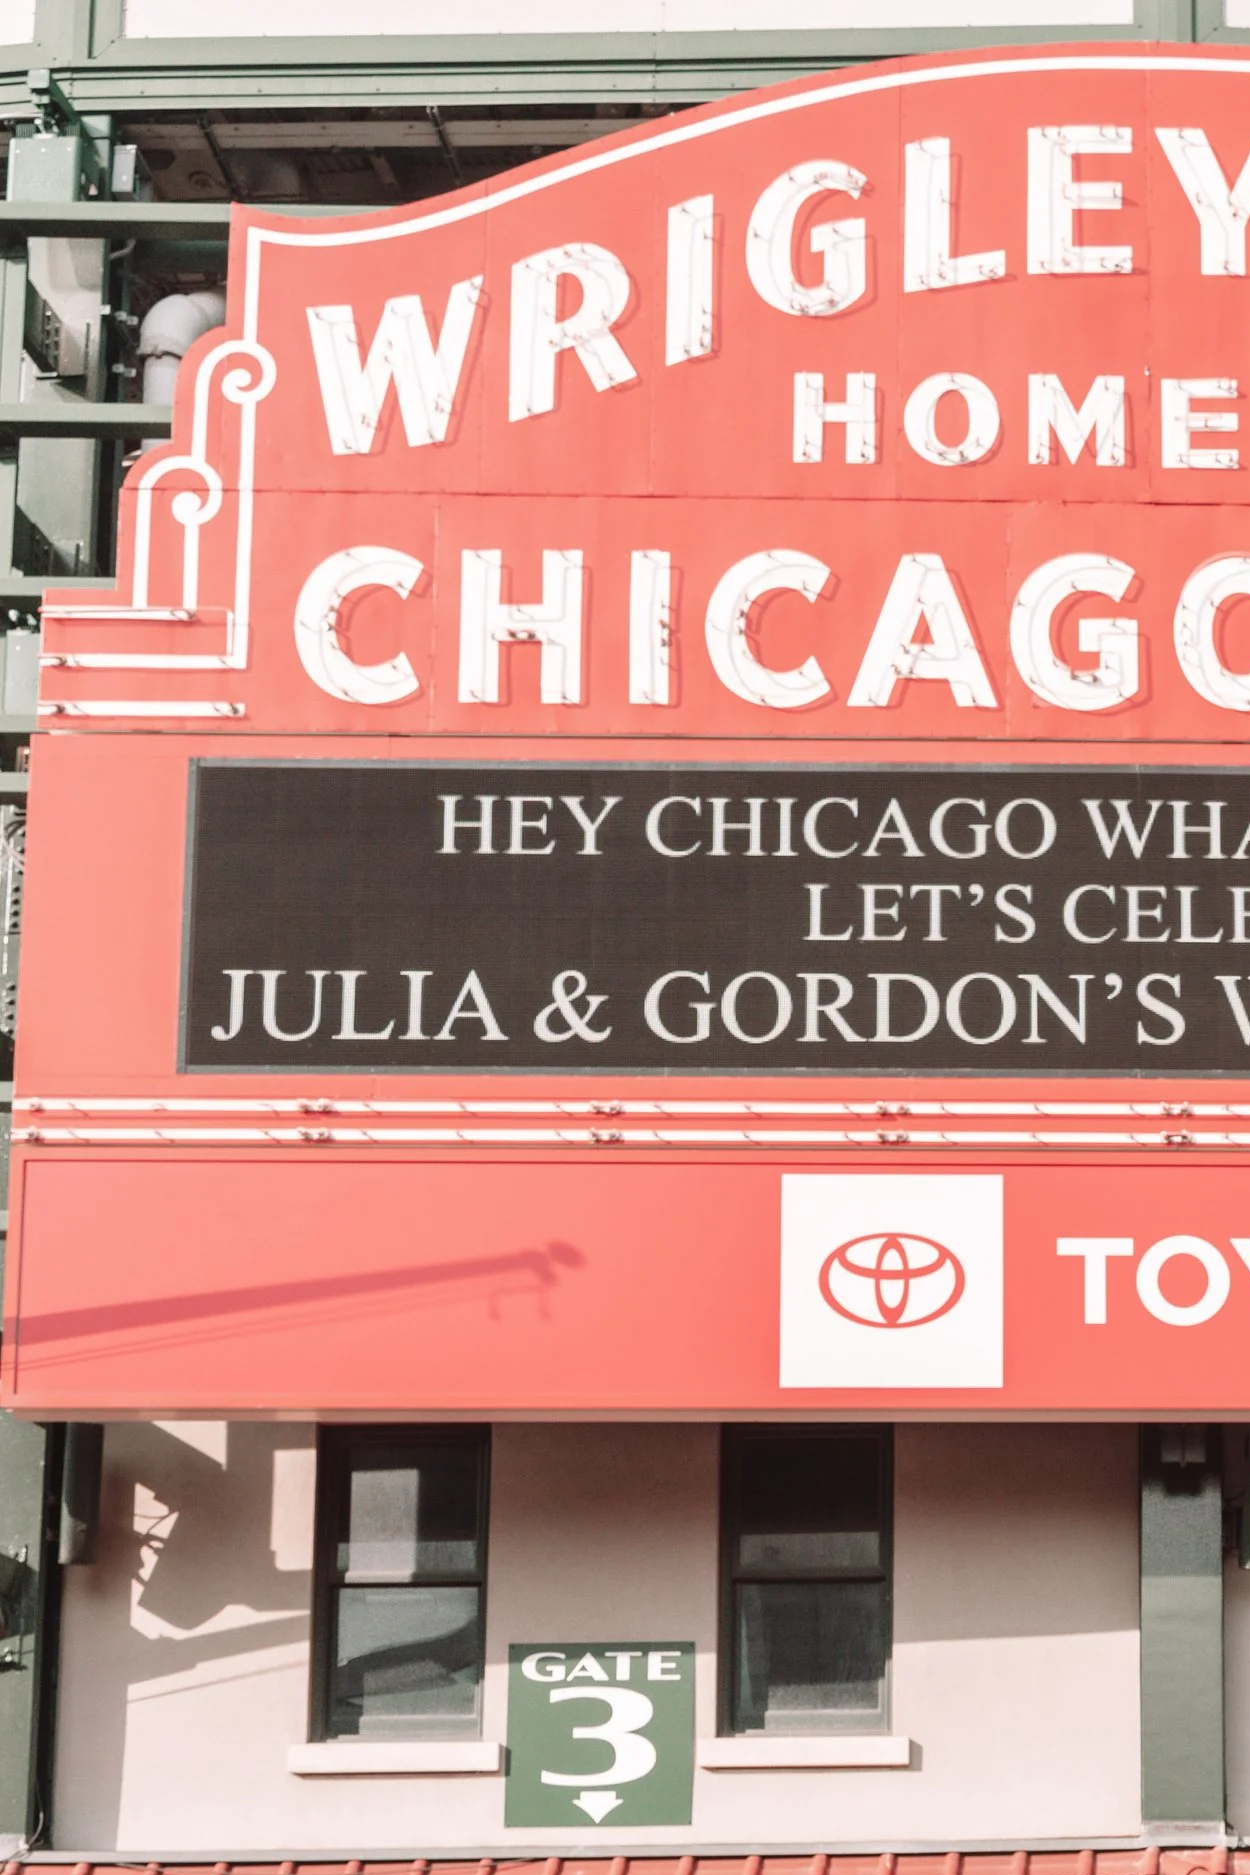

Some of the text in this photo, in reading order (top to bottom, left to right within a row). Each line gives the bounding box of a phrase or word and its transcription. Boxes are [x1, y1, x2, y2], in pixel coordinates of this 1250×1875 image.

[794, 373, 1241, 470] HOME
[438, 795, 620, 855] HEY
[645, 795, 1057, 860] CHICAGO
[804, 884, 1036, 944] LET'S
[211, 970, 508, 1042] JULIA
[534, 970, 612, 1043] &
[644, 971, 1186, 1046] GORDON'S
[521, 1651, 682, 1683] GATE
[541, 1686, 657, 1787] 3
